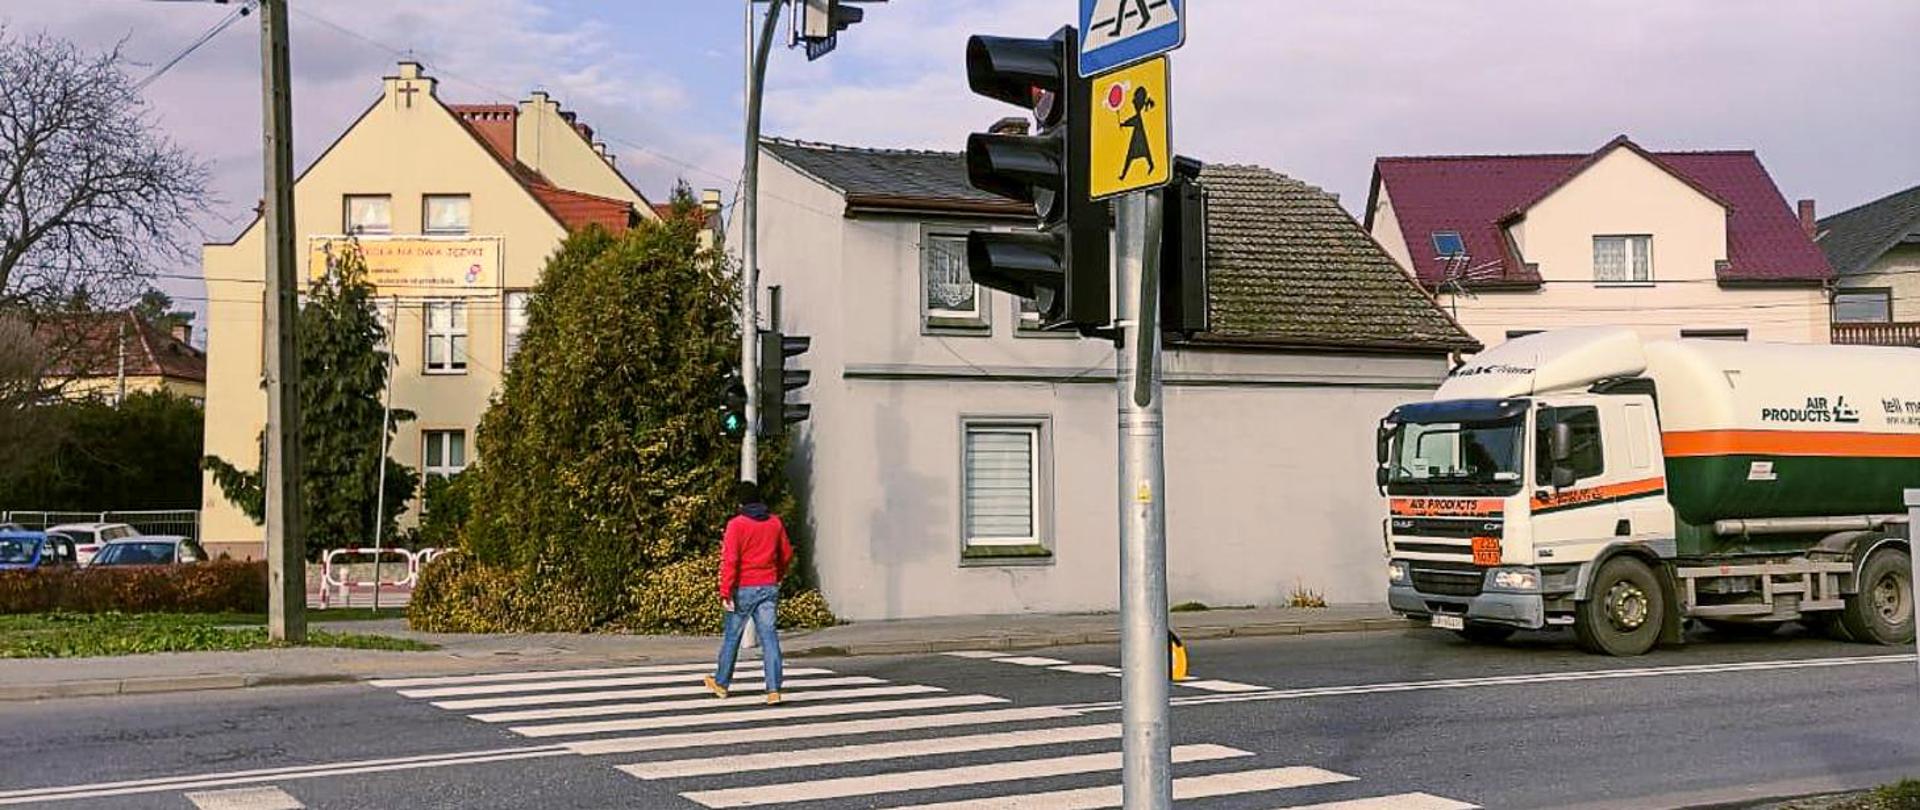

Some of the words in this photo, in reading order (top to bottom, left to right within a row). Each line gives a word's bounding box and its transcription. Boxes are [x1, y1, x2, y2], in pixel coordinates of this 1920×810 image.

[1806, 397, 1828, 409] AIR
[1881, 397, 1902, 413] tell
[1762, 408, 1831, 422] PRODUCTS
[1409, 499, 1426, 509] AIR
[1428, 500, 1478, 510] PRODUCTS
